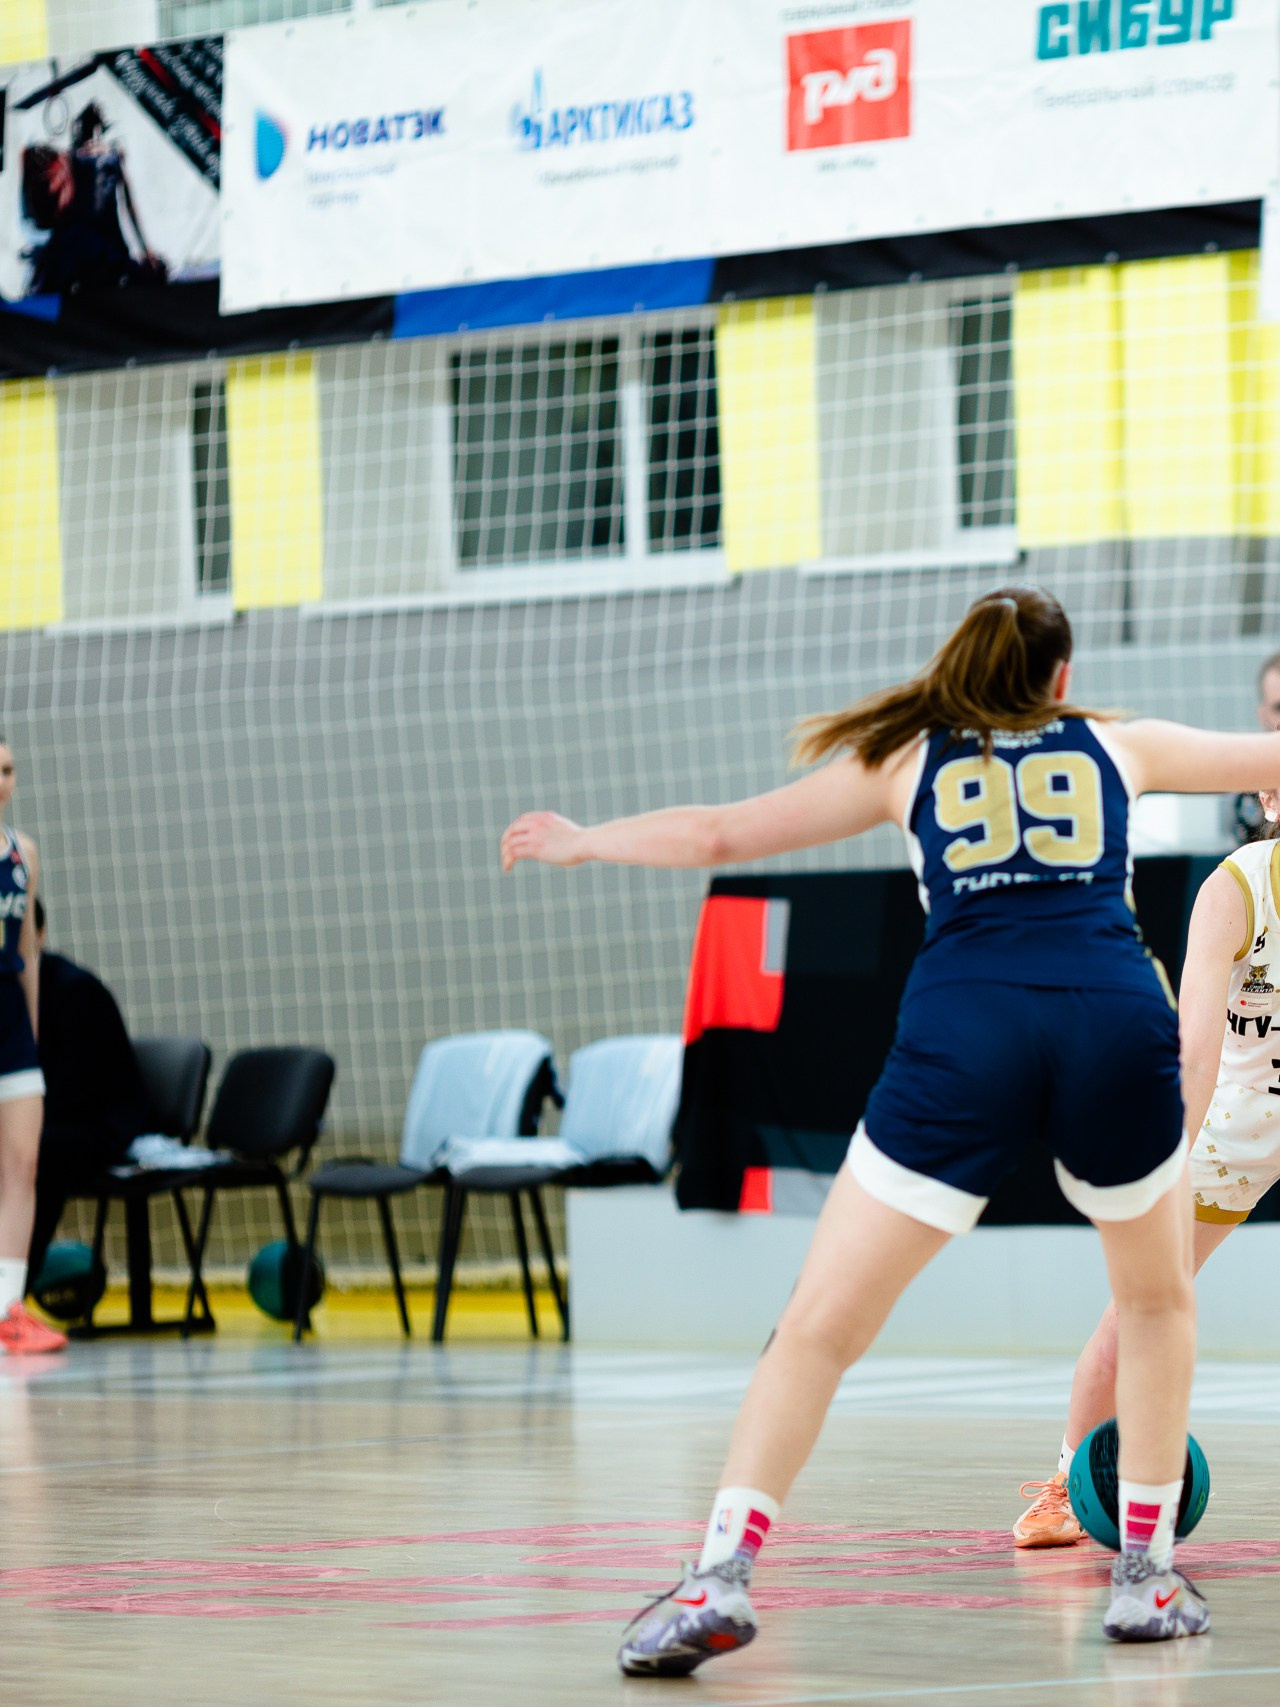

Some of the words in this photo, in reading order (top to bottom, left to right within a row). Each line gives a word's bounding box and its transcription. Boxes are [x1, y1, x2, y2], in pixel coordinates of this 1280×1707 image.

[1037, 0, 1233, 60] СИБУР
[307, 106, 446, 151] НОВАТЭК
[932, 750, 1105, 873] 99
